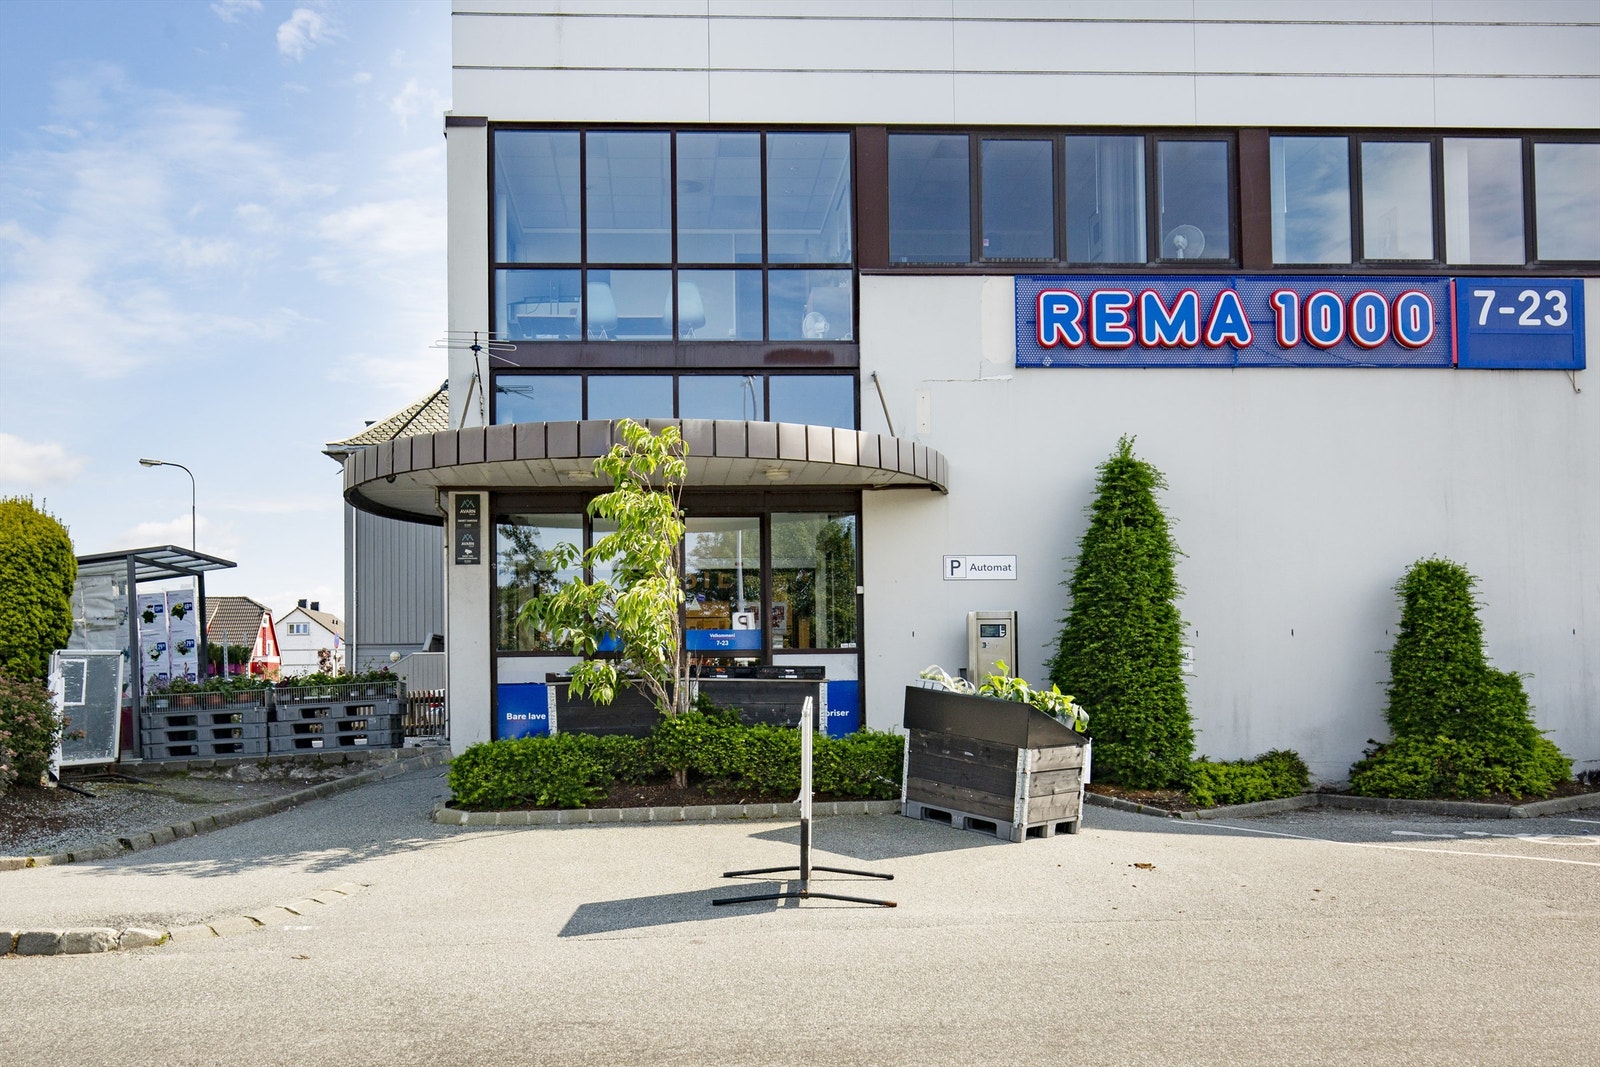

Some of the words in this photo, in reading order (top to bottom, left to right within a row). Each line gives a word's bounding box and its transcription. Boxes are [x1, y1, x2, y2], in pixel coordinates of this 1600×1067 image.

[1036, 288, 1255, 349] REMA
[1270, 288, 1437, 350] 1000
[1473, 289, 1569, 327] 7-23
[950, 559, 962, 576] P
[969, 563, 1012, 572] Automat
[506, 712, 527, 720] Bare
[528, 712, 546, 720] lave
